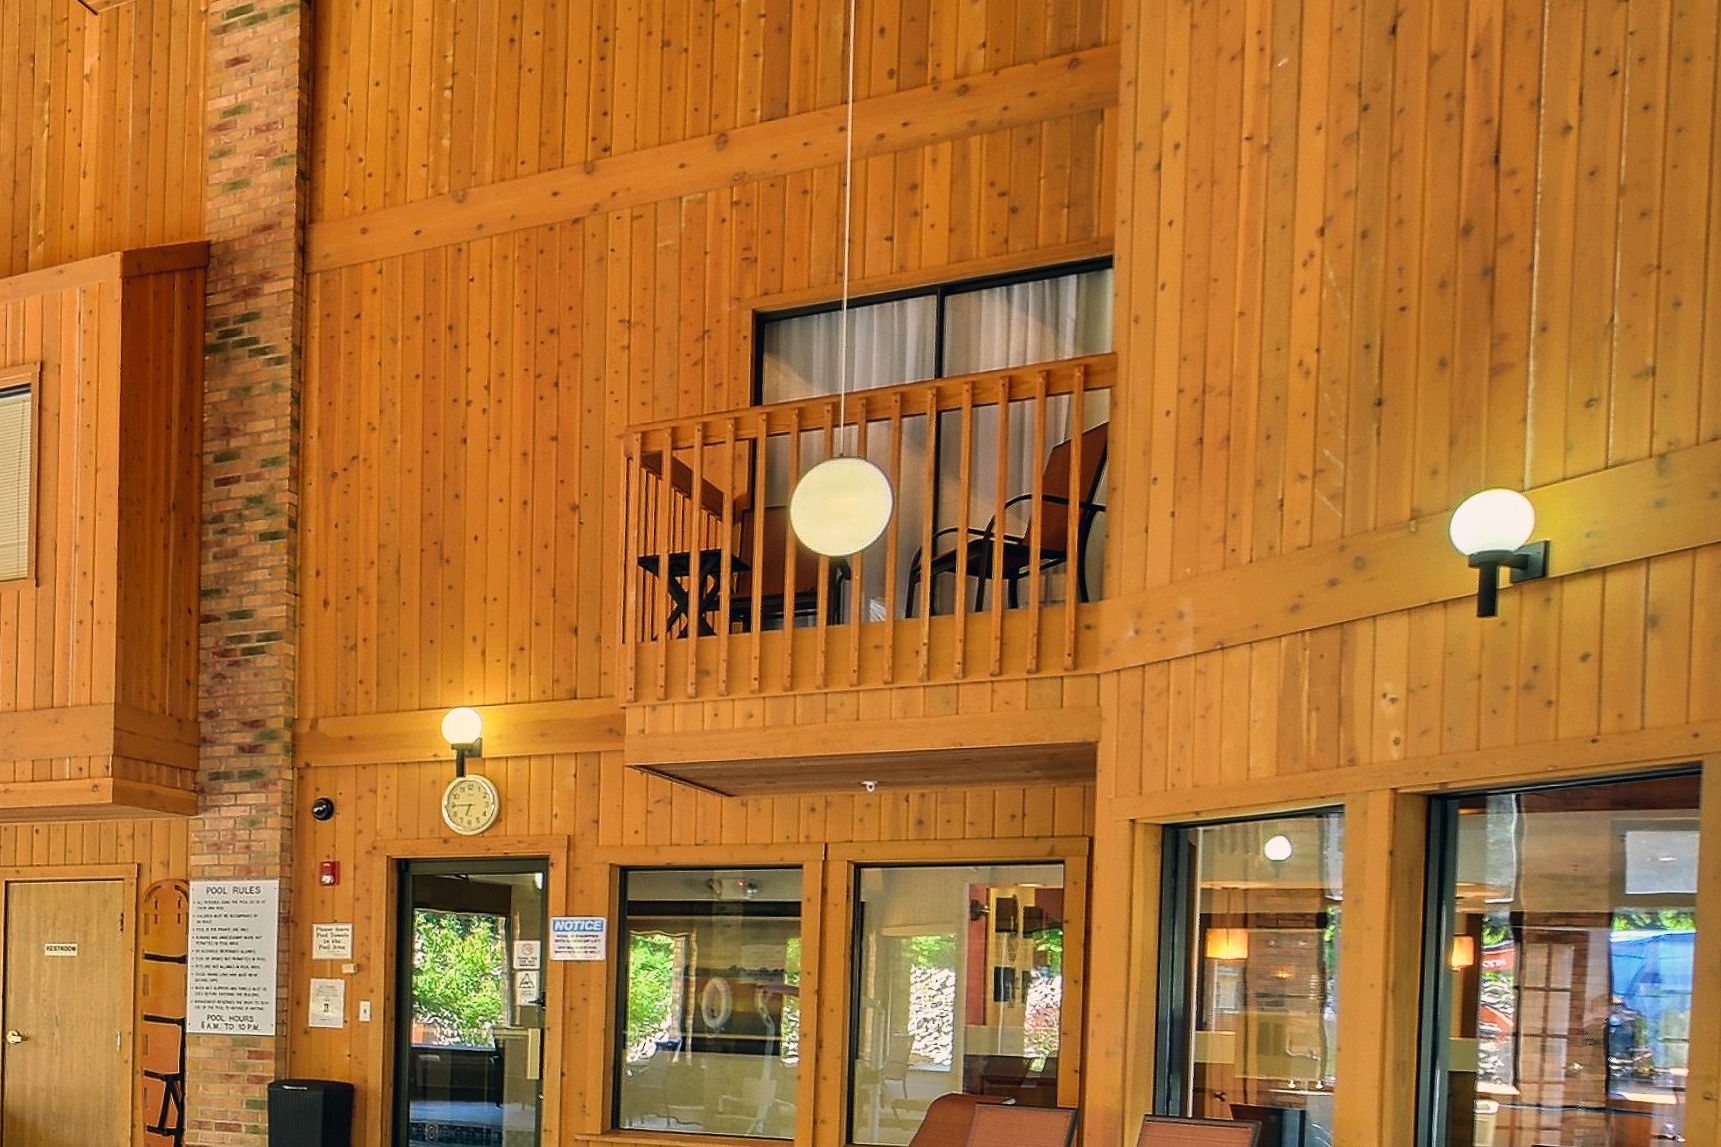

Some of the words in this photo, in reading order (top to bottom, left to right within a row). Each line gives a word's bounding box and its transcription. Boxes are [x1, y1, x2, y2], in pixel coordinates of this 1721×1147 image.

[206, 886, 228, 894] POOL
[232, 886, 262, 894] RULES
[554, 920, 602, 931] NOTICE
[206, 1014, 225, 1022] POOL
[224, 1022, 234, 1030] TO
